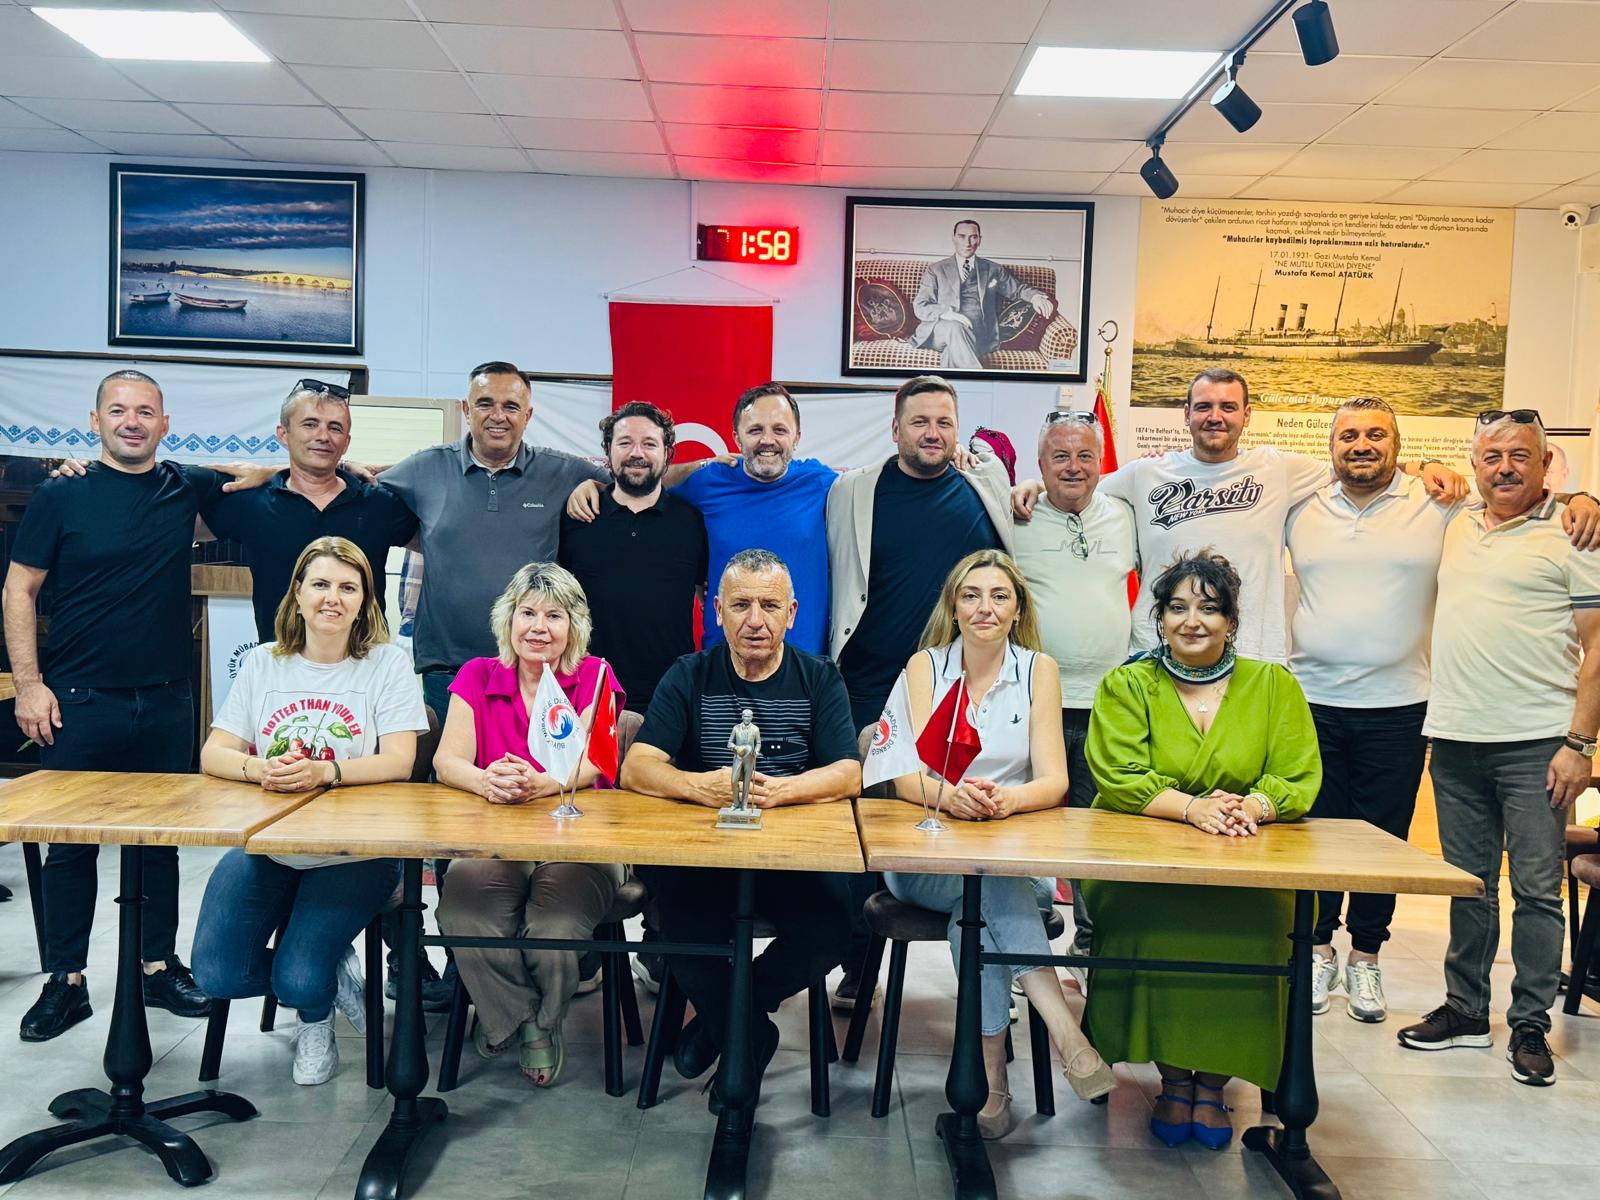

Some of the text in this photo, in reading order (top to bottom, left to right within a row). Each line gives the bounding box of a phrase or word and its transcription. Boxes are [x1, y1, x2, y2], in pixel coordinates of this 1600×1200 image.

[1338, 271, 1374, 279] ATATÜRK
[1277, 418, 1303, 428] Neden
[1148, 475, 1263, 518] Varsity
[1168, 512, 1188, 524] NEW
[228, 658, 238, 679] ÜYÜK
[262, 698, 362, 736] HOTTER THAN YOUR EX
